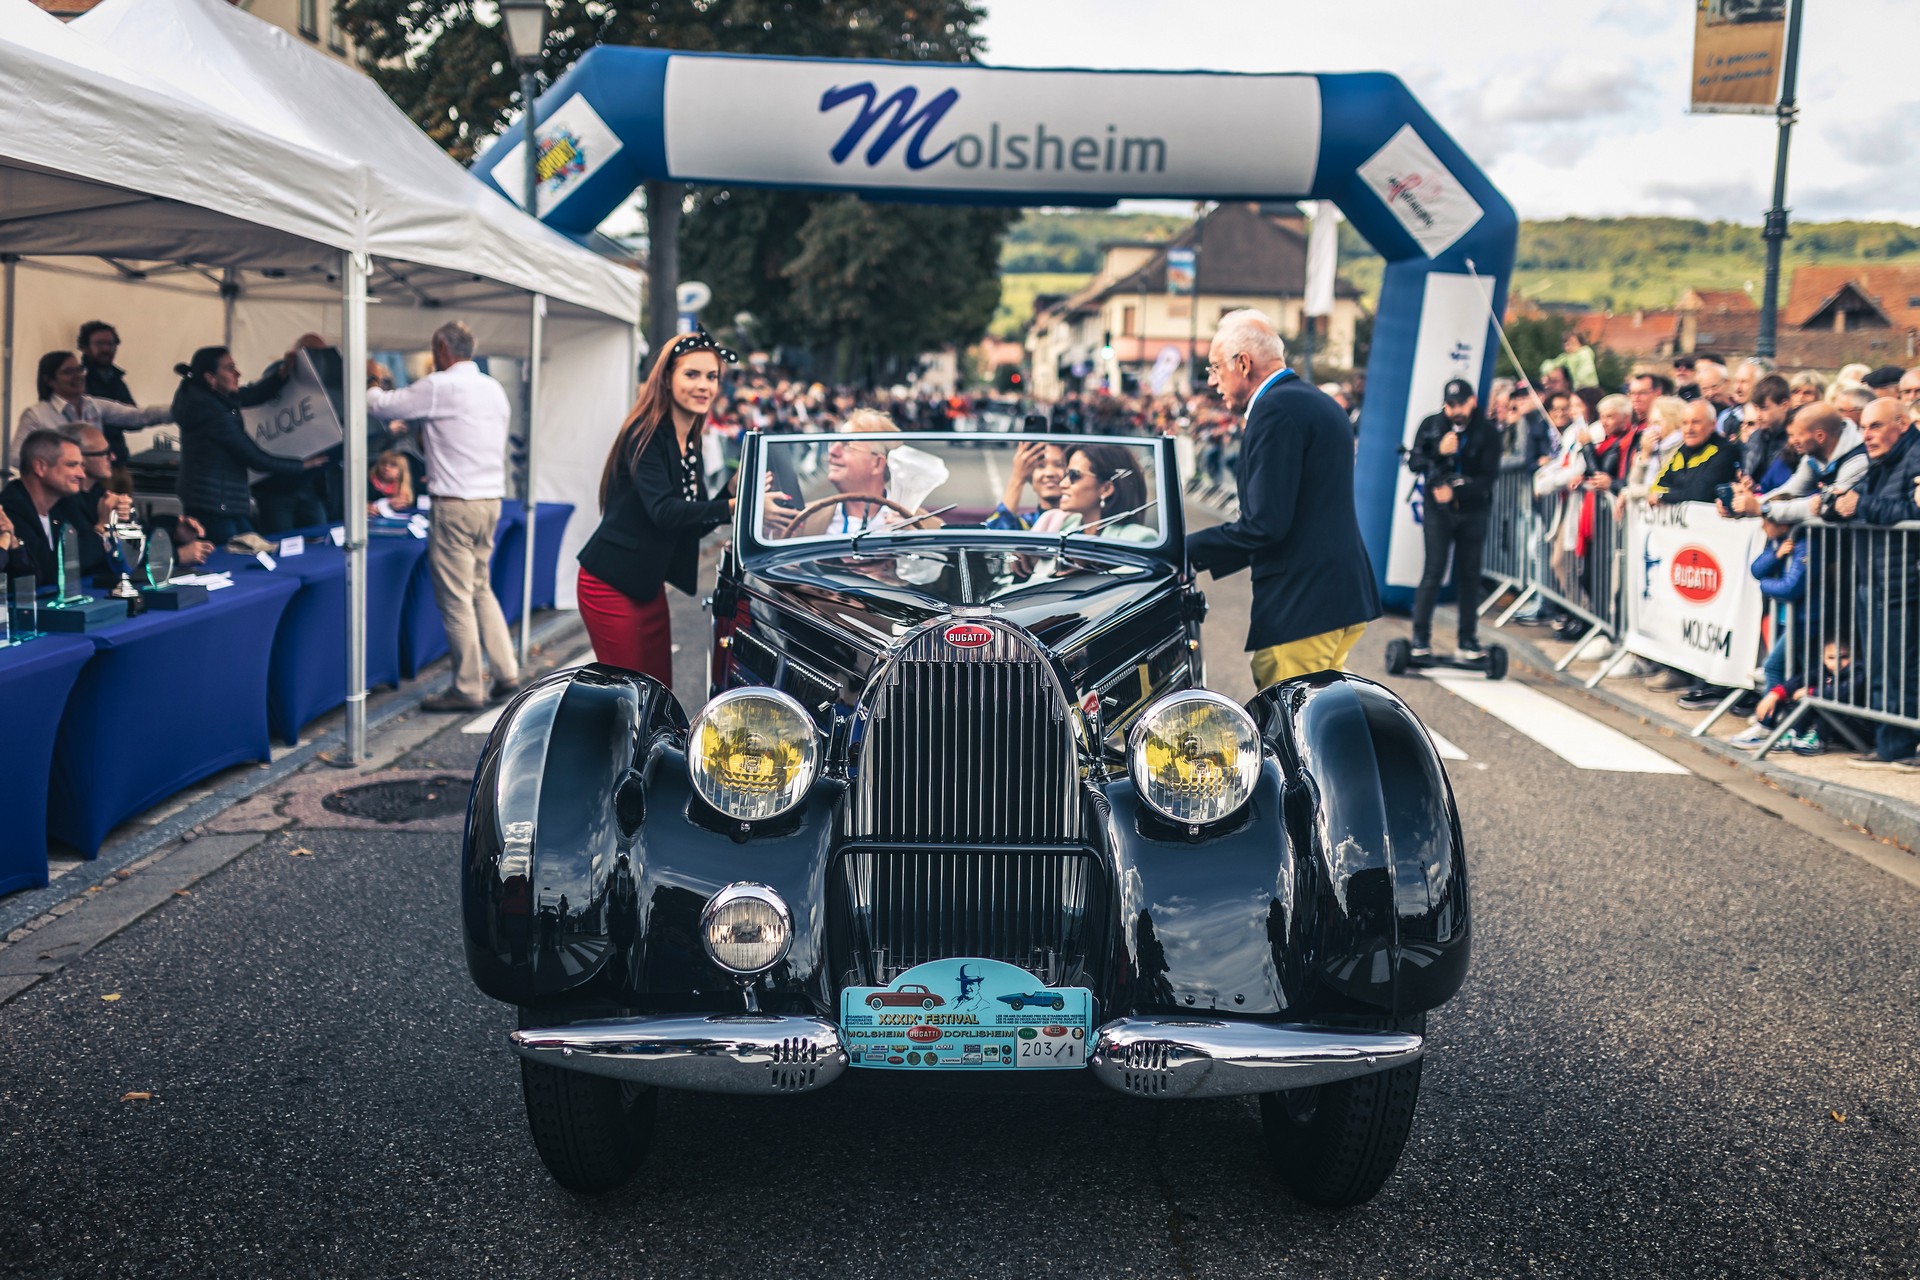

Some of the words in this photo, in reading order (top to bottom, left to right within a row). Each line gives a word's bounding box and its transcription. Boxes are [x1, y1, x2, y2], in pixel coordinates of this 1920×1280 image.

[818, 81, 1168, 173] Molsheim
[1673, 563, 1718, 592] BUGATTI
[949, 633, 987, 642] BUGATTI
[1682, 618, 1733, 659] MOLSHM
[925, 1013, 980, 1025] FESTIVAL
[910, 1030, 939, 1038] BUGATTI
